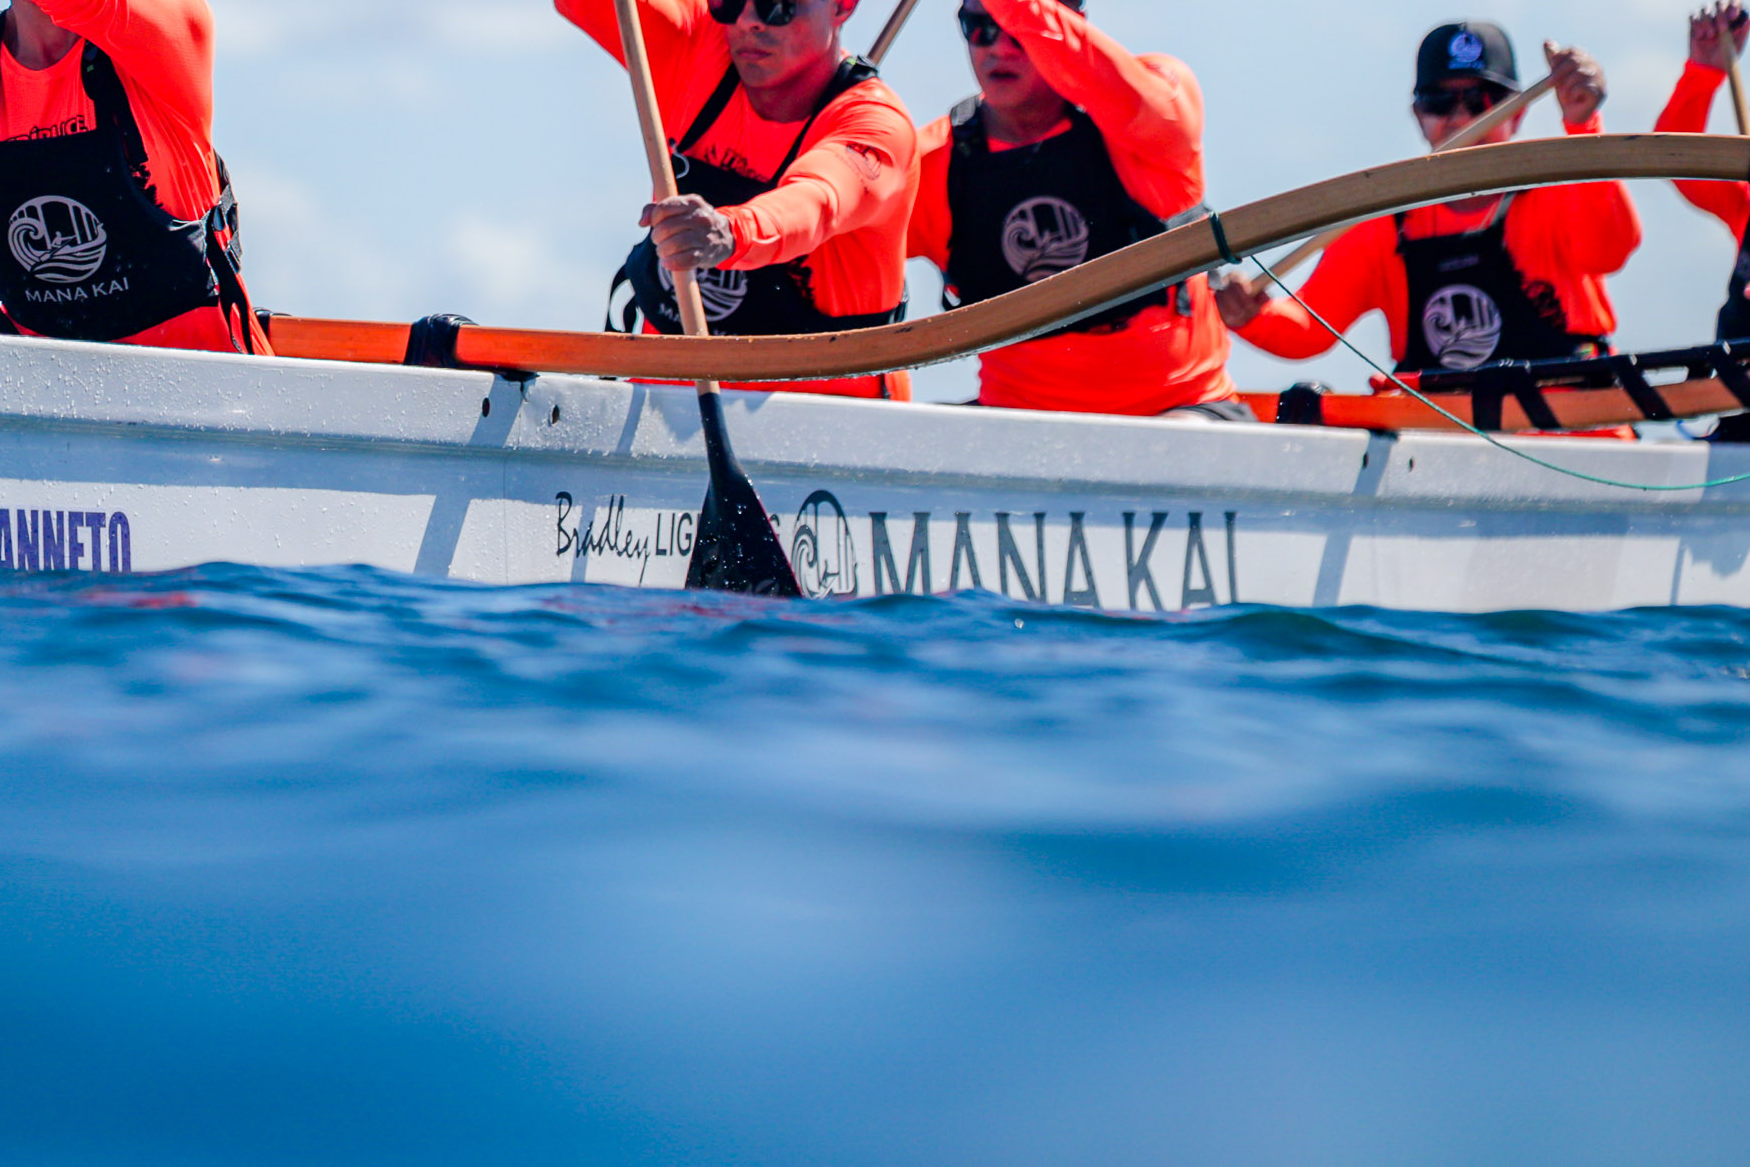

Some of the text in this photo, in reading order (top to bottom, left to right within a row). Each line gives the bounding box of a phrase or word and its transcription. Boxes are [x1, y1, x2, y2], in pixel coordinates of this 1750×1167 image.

[25, 276, 130, 303] MANA KAI
[555, 491, 652, 586] Bradley
[868, 510, 1238, 613] MANA KAI
